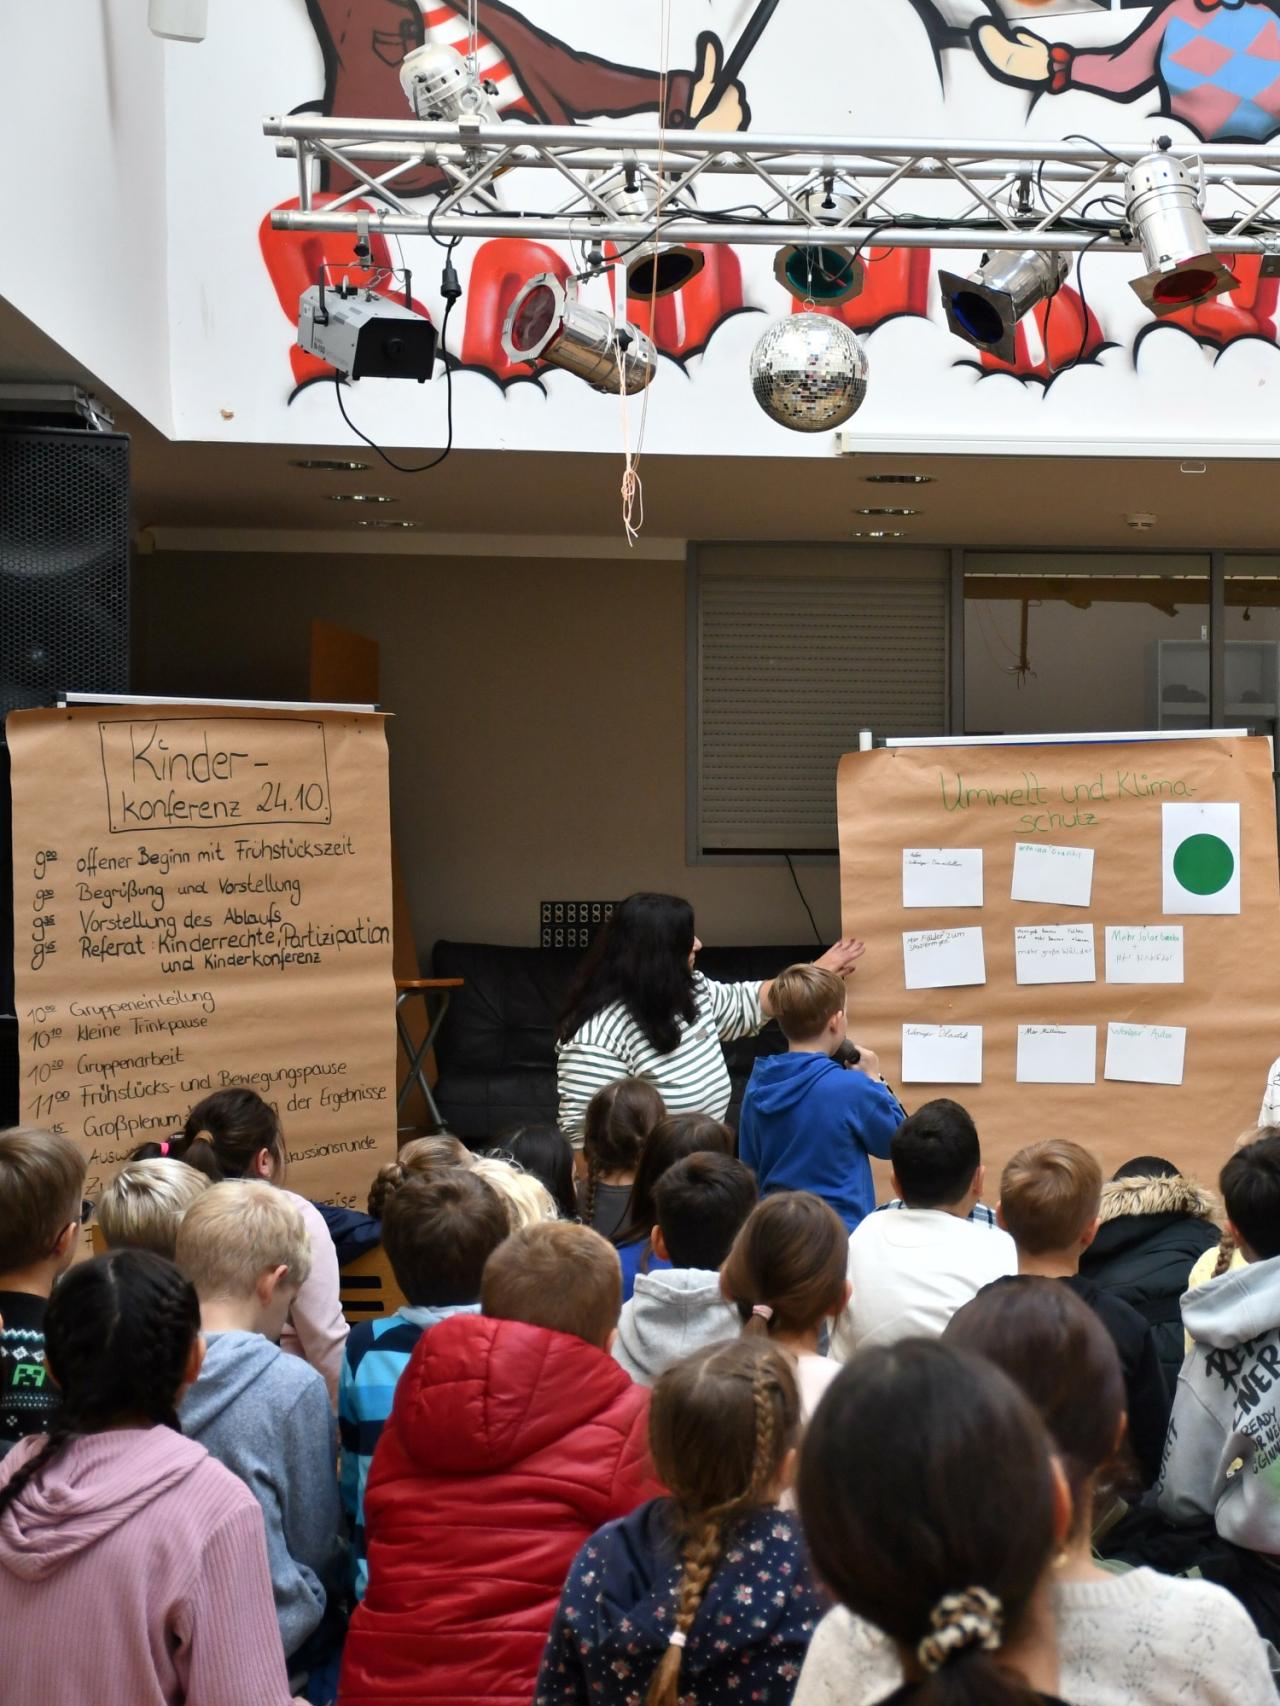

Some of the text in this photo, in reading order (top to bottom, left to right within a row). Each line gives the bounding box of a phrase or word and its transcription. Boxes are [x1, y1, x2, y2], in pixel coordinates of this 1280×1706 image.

[122, 790, 242, 822] konferenz
[939, 770, 1048, 811] Umwelt
[1060, 772, 1107, 801] und
[1013, 806, 1100, 835] schutz
[76, 846, 133, 877] offener
[137, 846, 190, 875] Beginn
[198, 841, 225, 863] mit
[234, 835, 356, 861] Frühstückszeit
[76, 879, 166, 912] Begrüßung
[177, 881, 208, 895] und
[219, 873, 302, 907] Vorstellung
[79, 909, 177, 939] Vorstellung
[183, 910, 213, 930] des
[224, 901, 283, 929] Ablaufs
[280, 917, 391, 952] Partizipation
[161, 947, 322, 974] und Kinderkonferenz
[69, 990, 217, 1021] Gruppeneinteilung
[77, 1024, 121, 1043] kleine
[128, 1016, 209, 1036] Trinkpause
[77, 1046, 185, 1080] Gruppenarbeit
[80, 1080, 176, 1108] Frühstücks-
[180, 1073, 212, 1092] und
[216, 1061, 348, 1093] Bewegungspause
[286, 1093, 313, 1113] der
[320, 1083, 389, 1113] Ergebnisse
